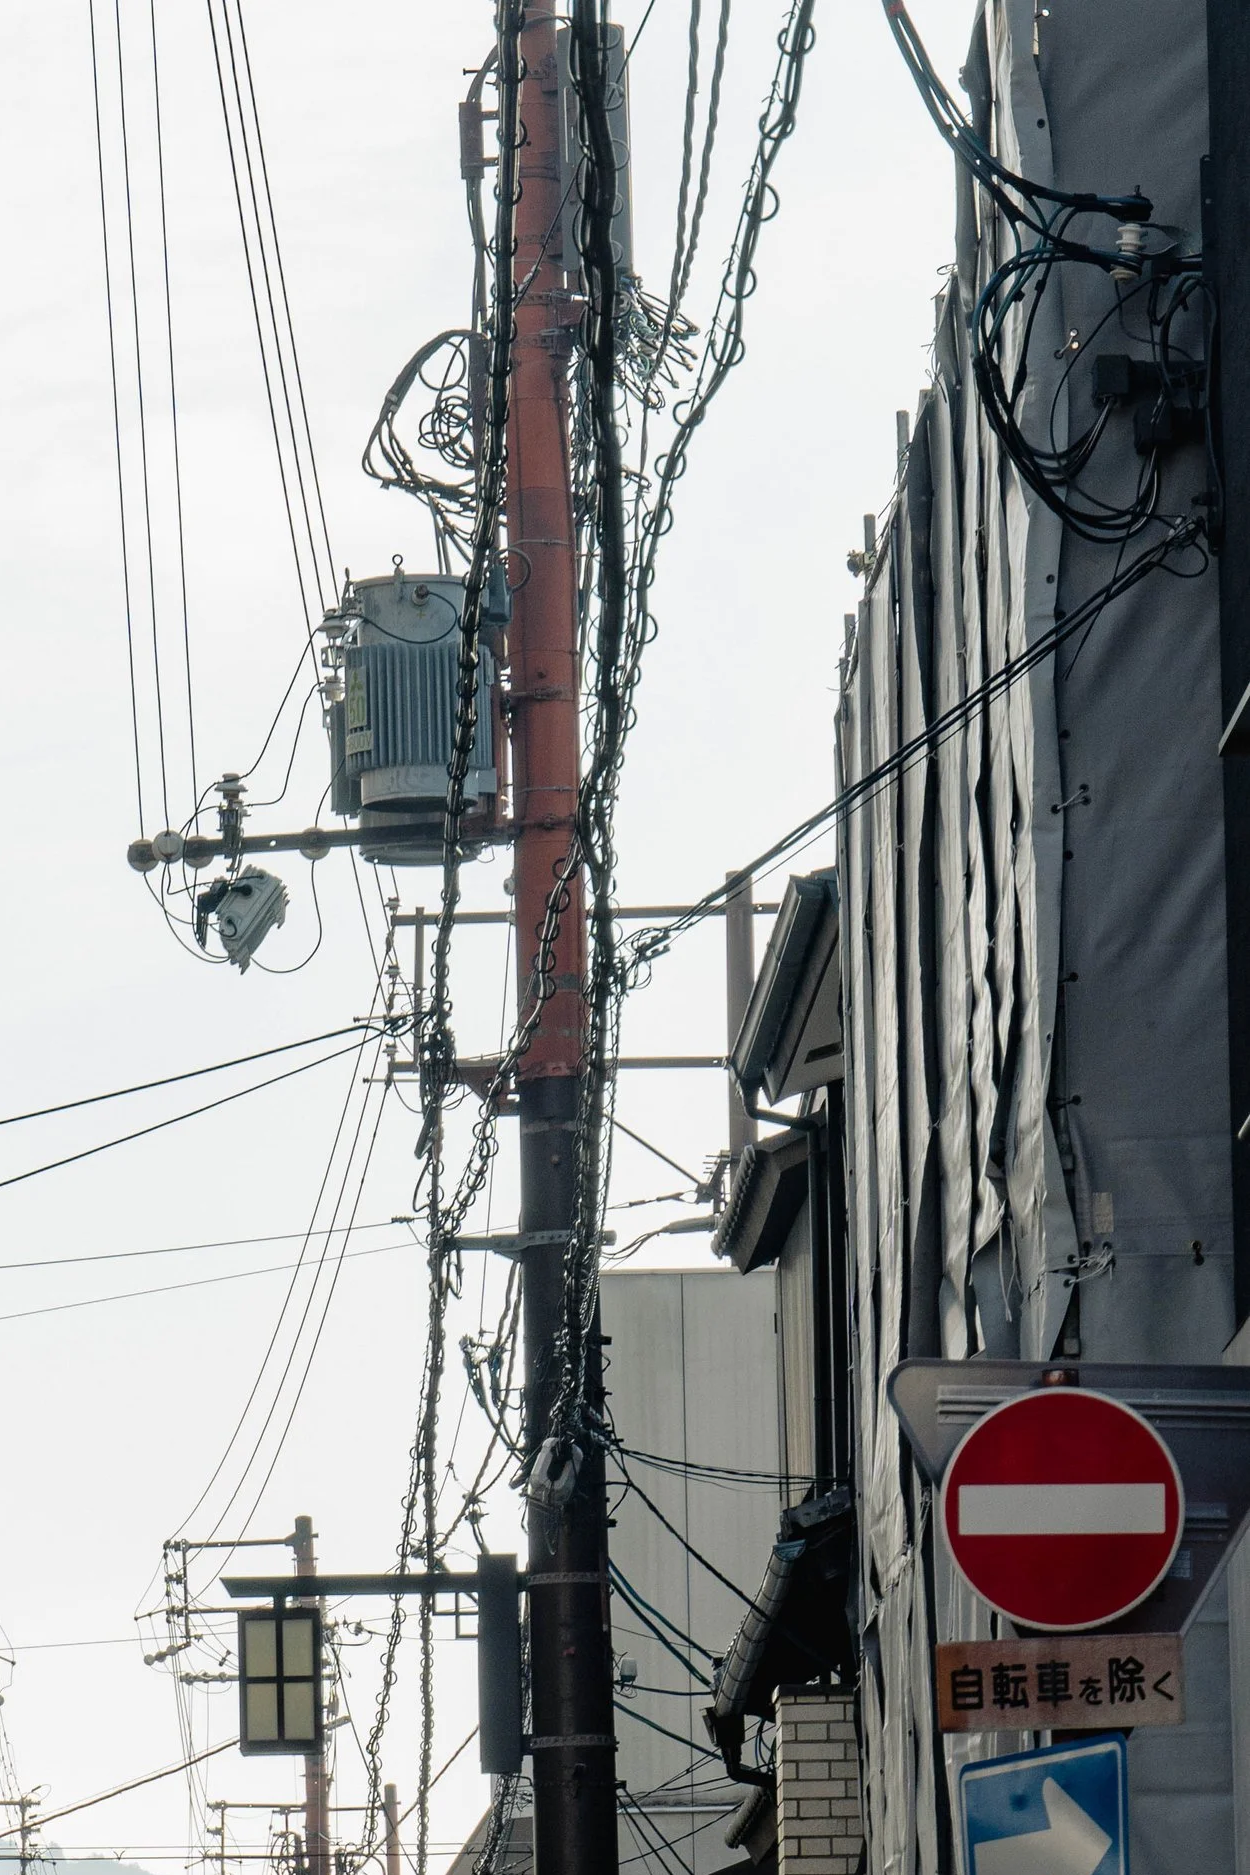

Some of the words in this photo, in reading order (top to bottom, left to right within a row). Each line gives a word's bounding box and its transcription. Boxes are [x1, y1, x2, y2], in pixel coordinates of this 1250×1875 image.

[950, 1656, 1174, 1710] 自転車を除く
